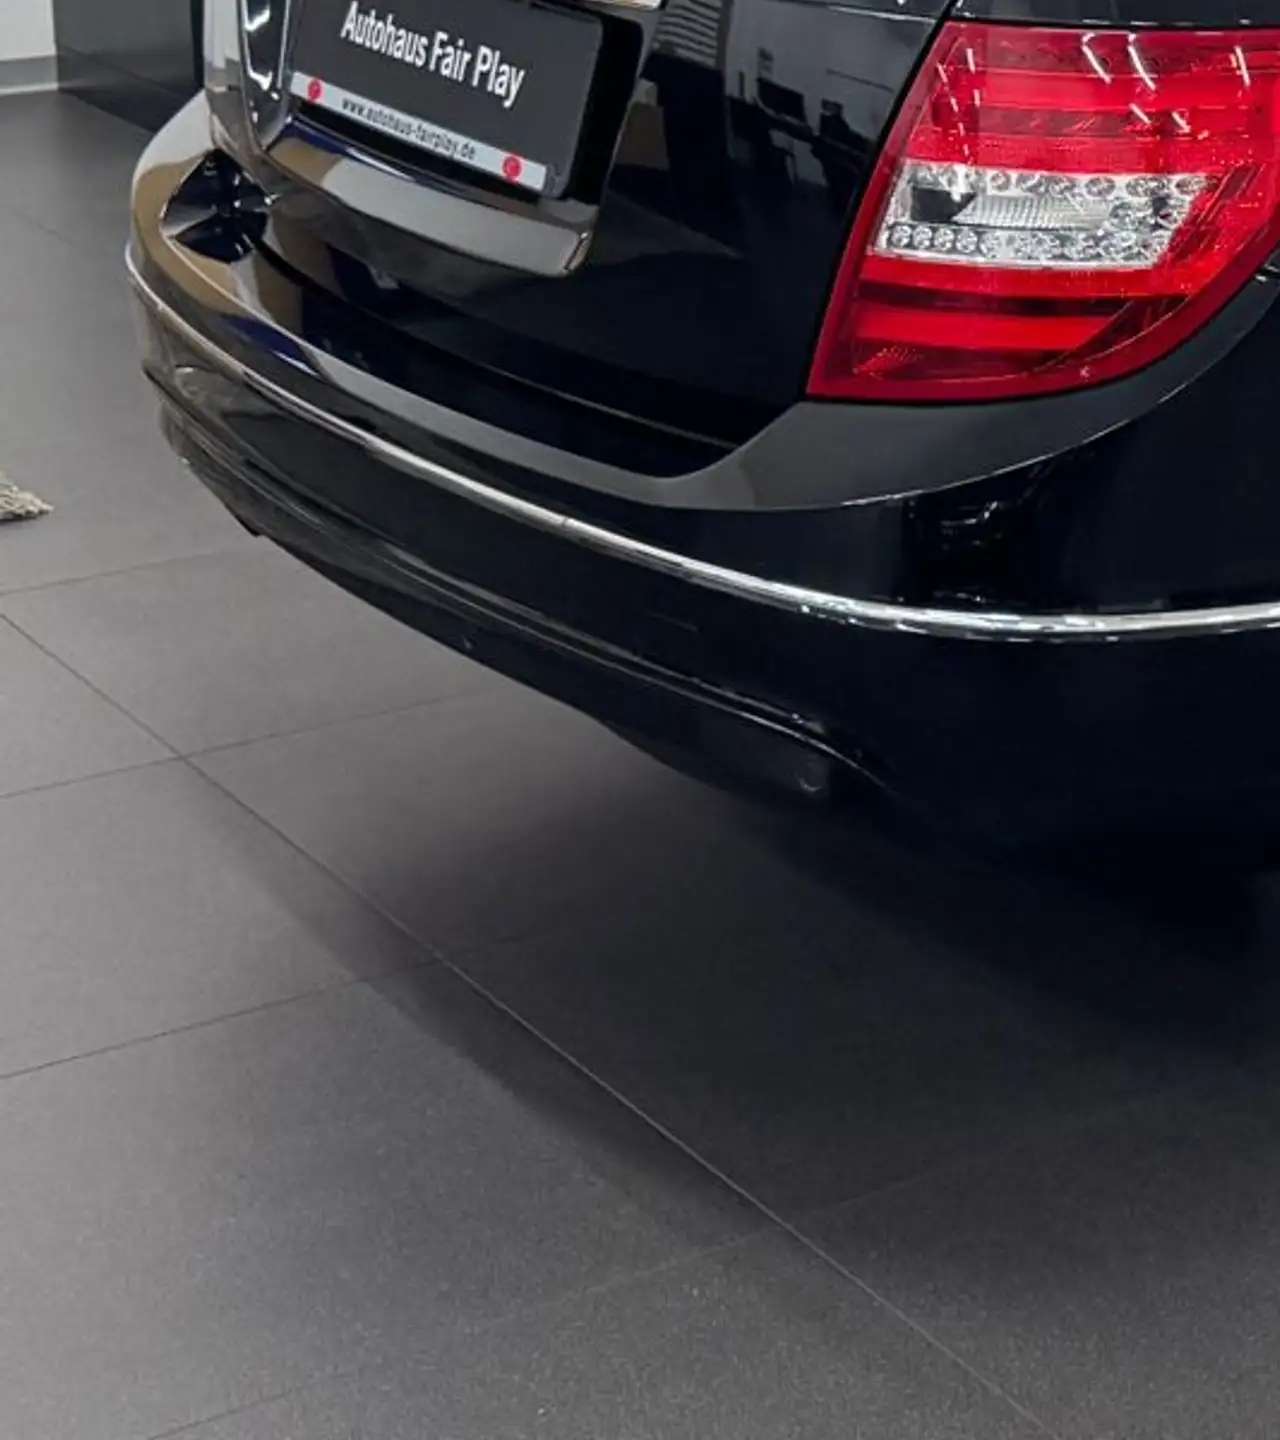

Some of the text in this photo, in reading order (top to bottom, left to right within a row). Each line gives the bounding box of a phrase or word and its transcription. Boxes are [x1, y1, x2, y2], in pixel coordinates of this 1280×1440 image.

[339, 0, 526, 109] Autohaus Fair Play
[341, 97, 477, 161] www.autohaus-fairplay.de
